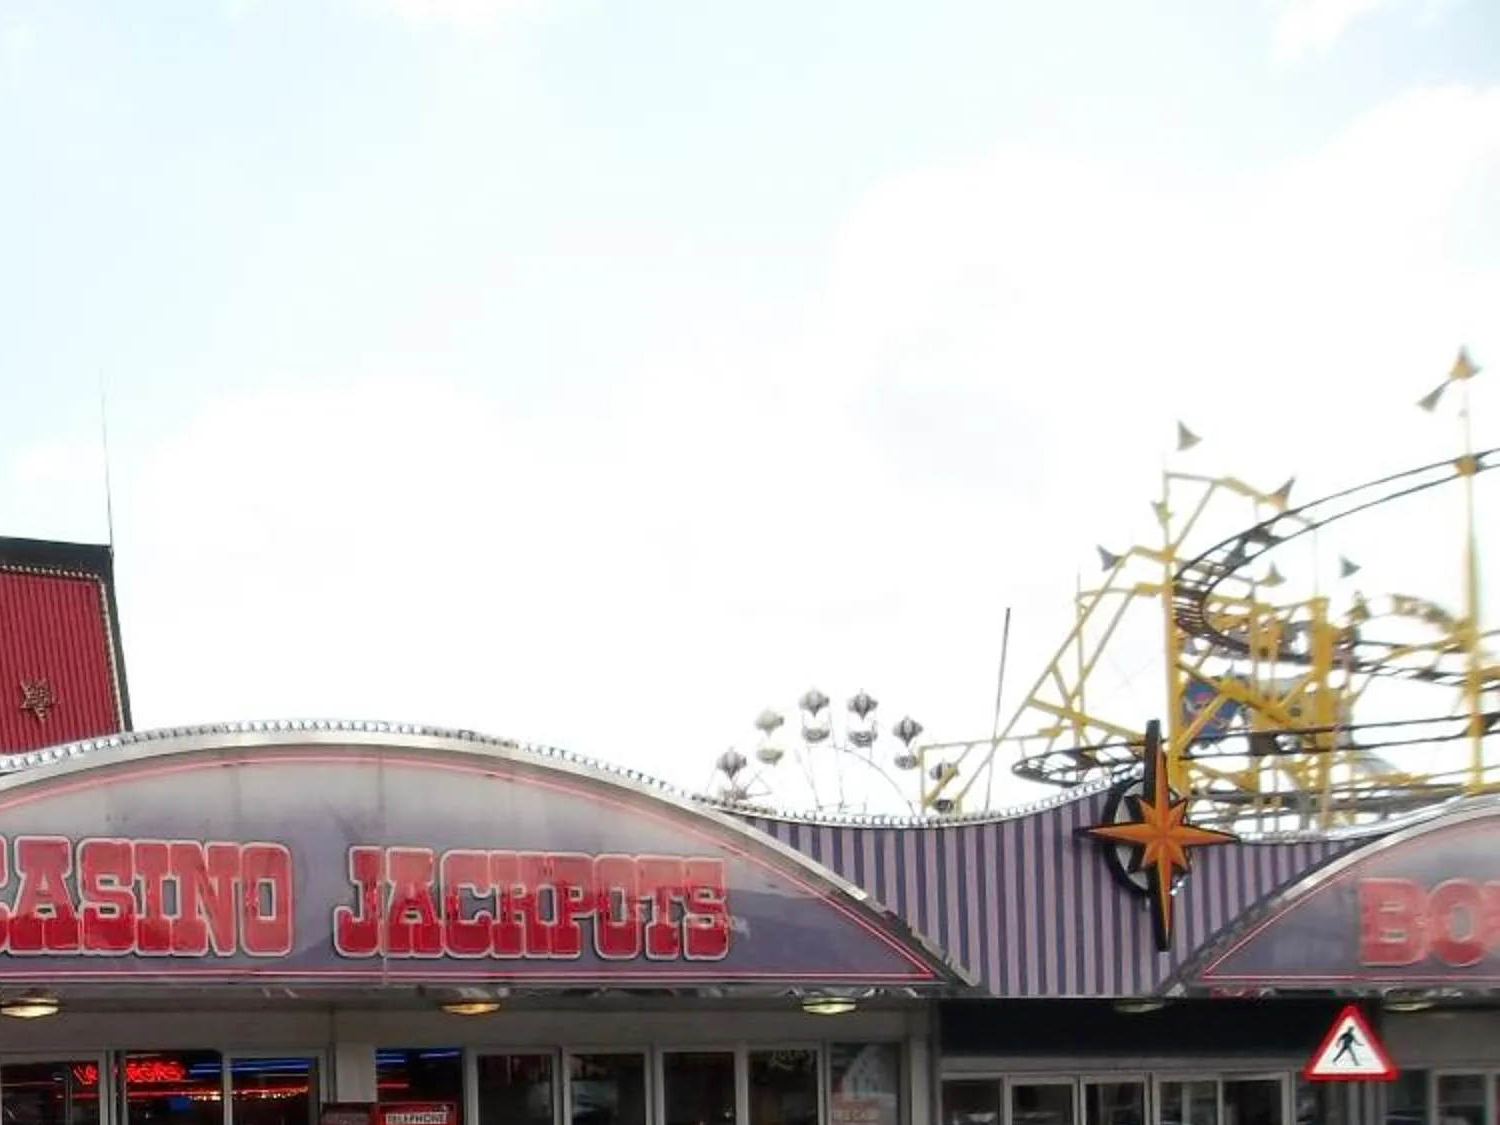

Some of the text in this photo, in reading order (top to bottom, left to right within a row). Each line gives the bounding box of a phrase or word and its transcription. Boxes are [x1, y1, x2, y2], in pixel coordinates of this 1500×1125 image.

[333, 845, 731, 960] JACKPOTS
[1358, 876, 1500, 967] BO
[387, 1112, 446, 1124] TELEPHONE
